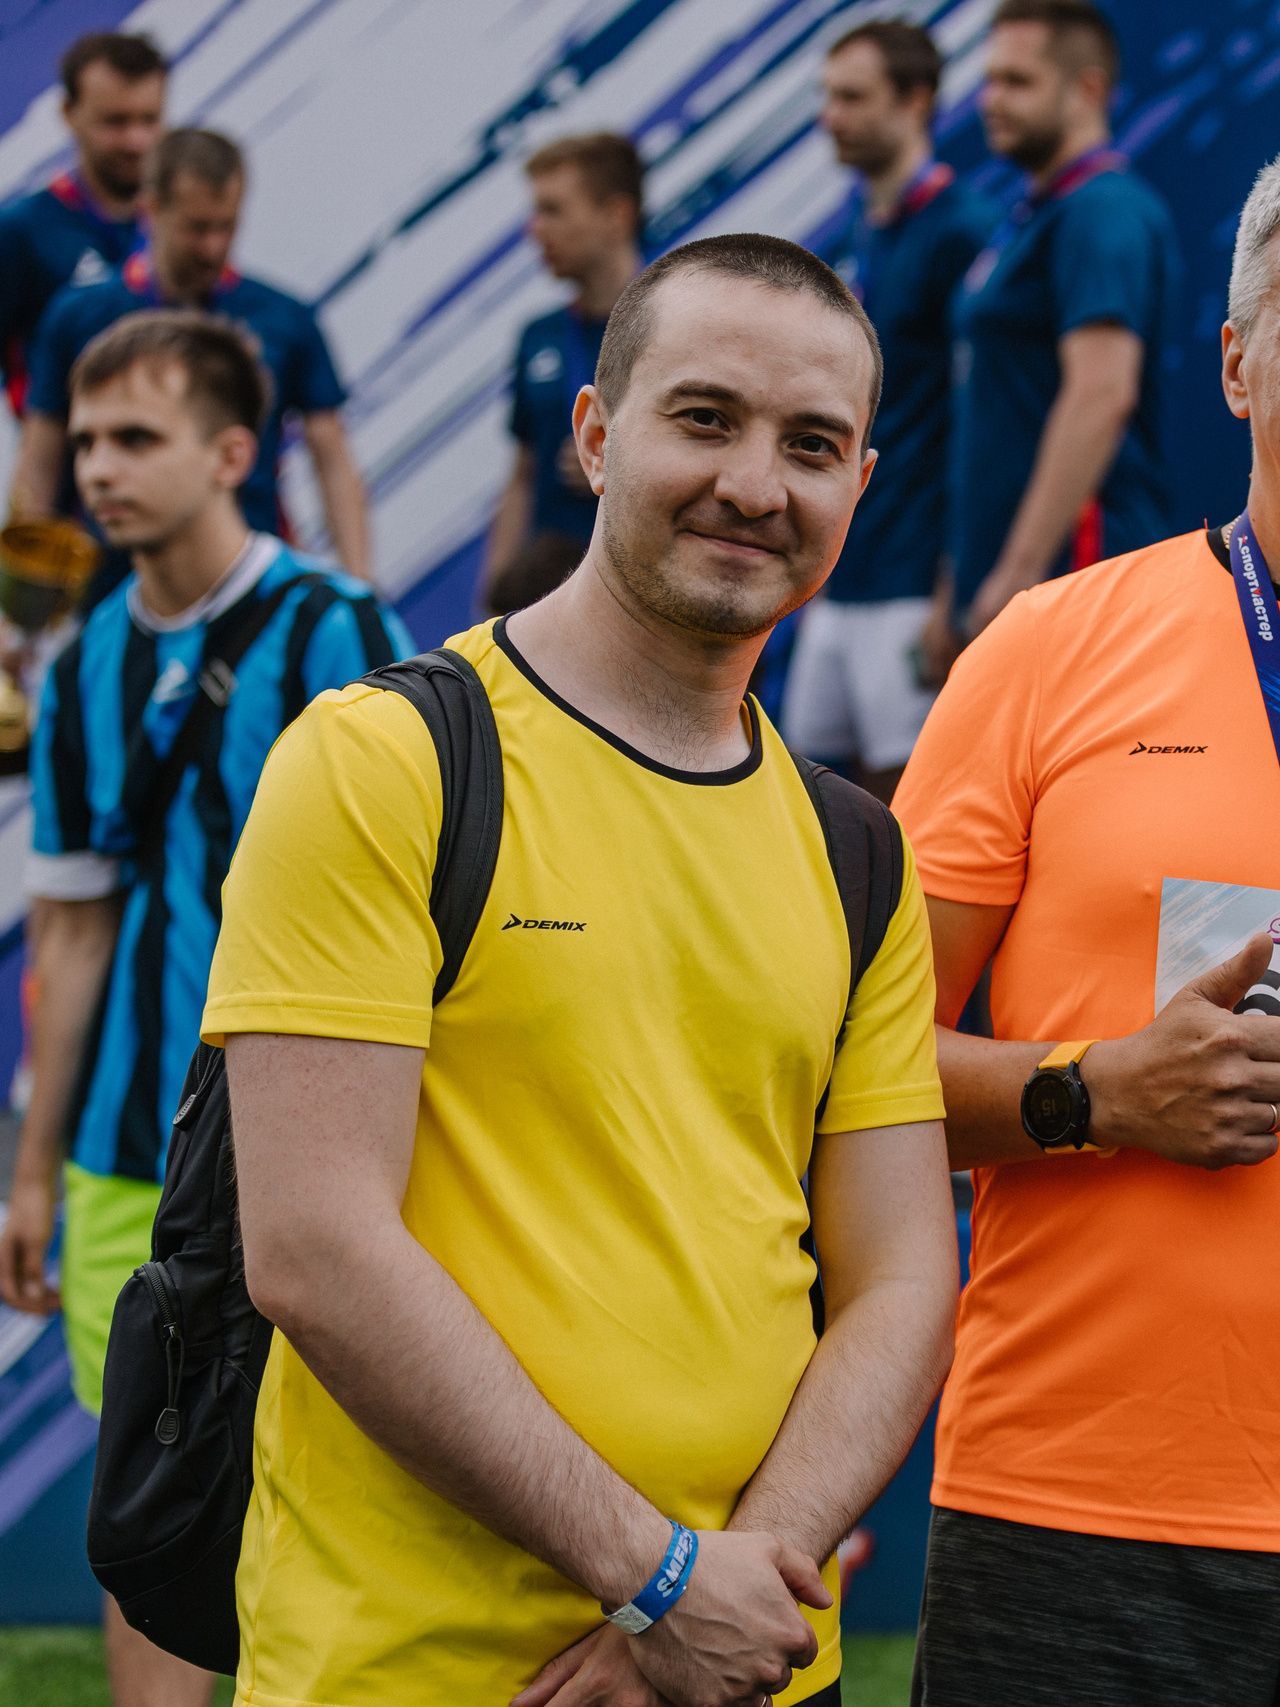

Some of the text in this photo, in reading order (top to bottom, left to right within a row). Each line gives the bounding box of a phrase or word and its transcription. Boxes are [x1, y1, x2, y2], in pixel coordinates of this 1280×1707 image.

[1240, 544, 1274, 642] спортмастер
[1147, 745, 1209, 754] DEMIX
[521, 919, 587, 932] DEMIX
